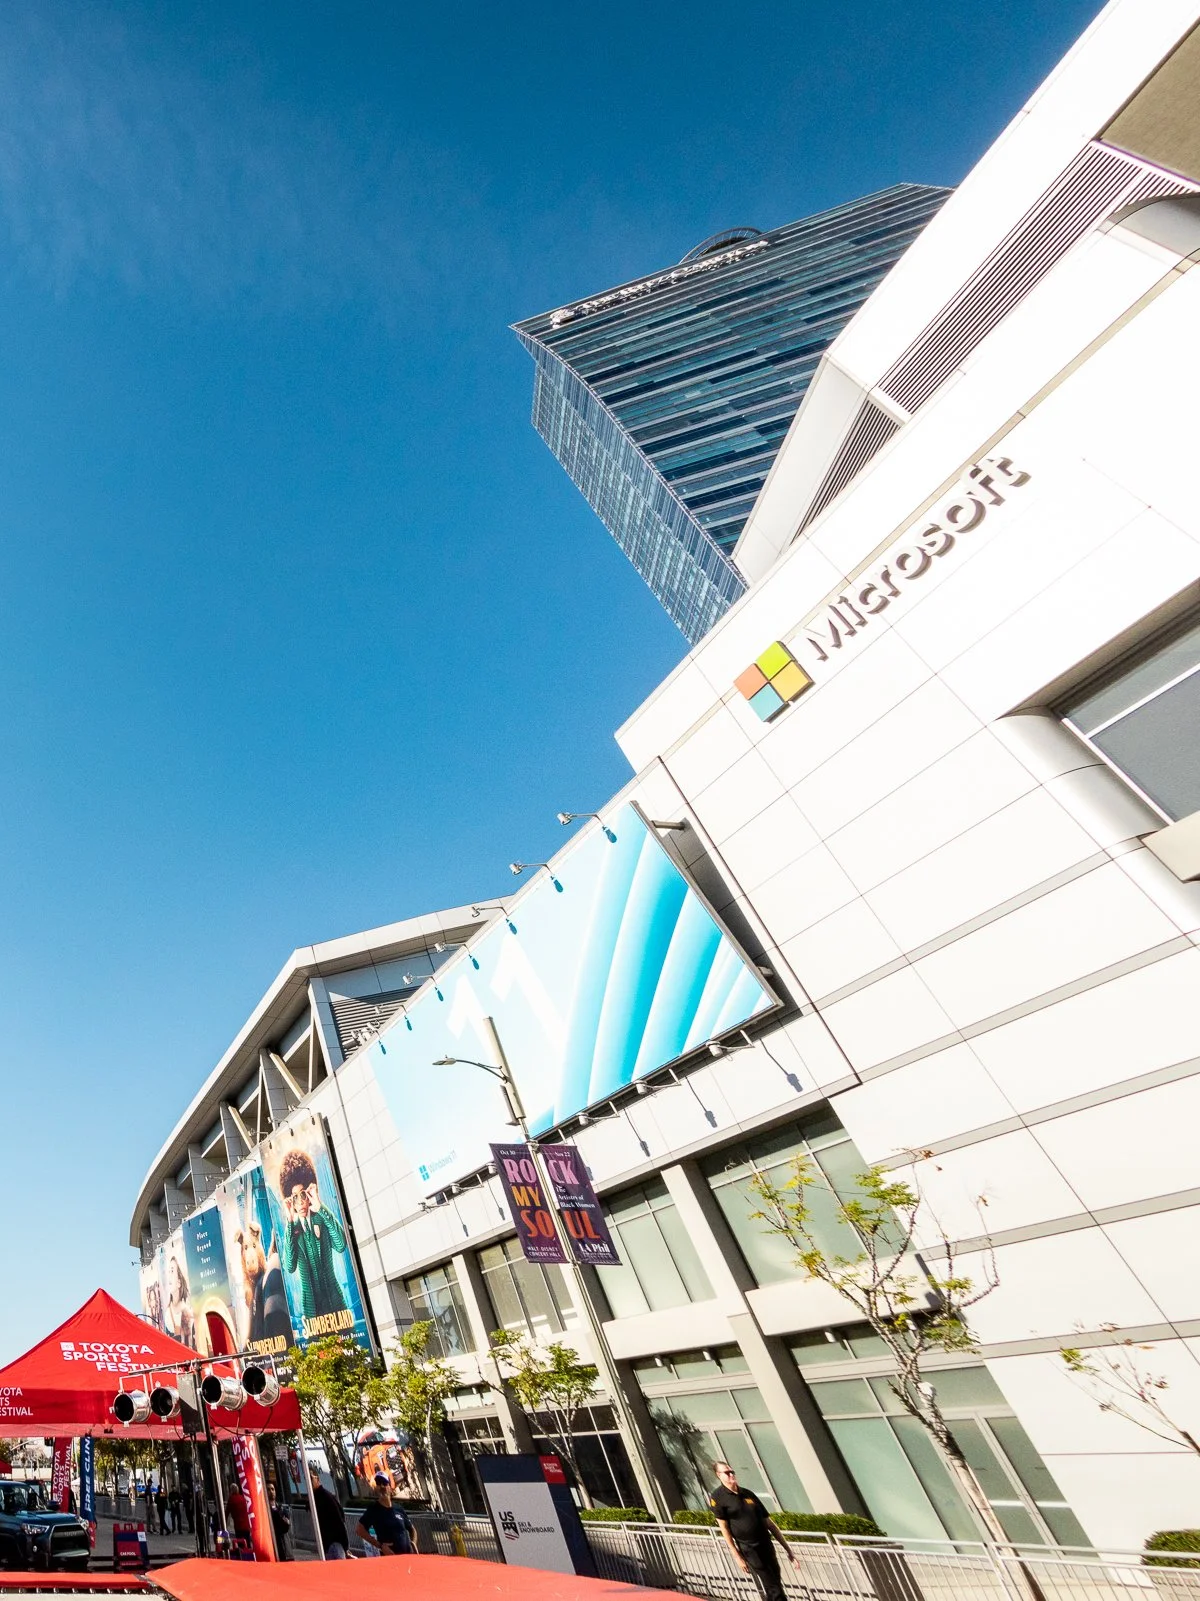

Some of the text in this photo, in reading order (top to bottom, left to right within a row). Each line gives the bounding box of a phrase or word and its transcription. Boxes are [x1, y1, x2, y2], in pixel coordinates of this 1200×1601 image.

[796, 455, 1033, 663] Microsoft
[511, 1185, 541, 1207] MY
[555, 1185, 566, 1193] The
[301, 1308, 355, 1339] SLUMBERLAND
[79, 1342, 154, 1355] TOYOTA
[246, 1334, 287, 1356] SLUMBERLAND
[63, 1351, 132, 1363] SPORTS
[95, 1362, 184, 1374] FESTI
[52, 1450, 61, 1493] TOYOTA
[63, 1443, 72, 1488] FESTIVAL
[84, 1475, 92, 1512] FREE
[498, 1511, 515, 1522] US
